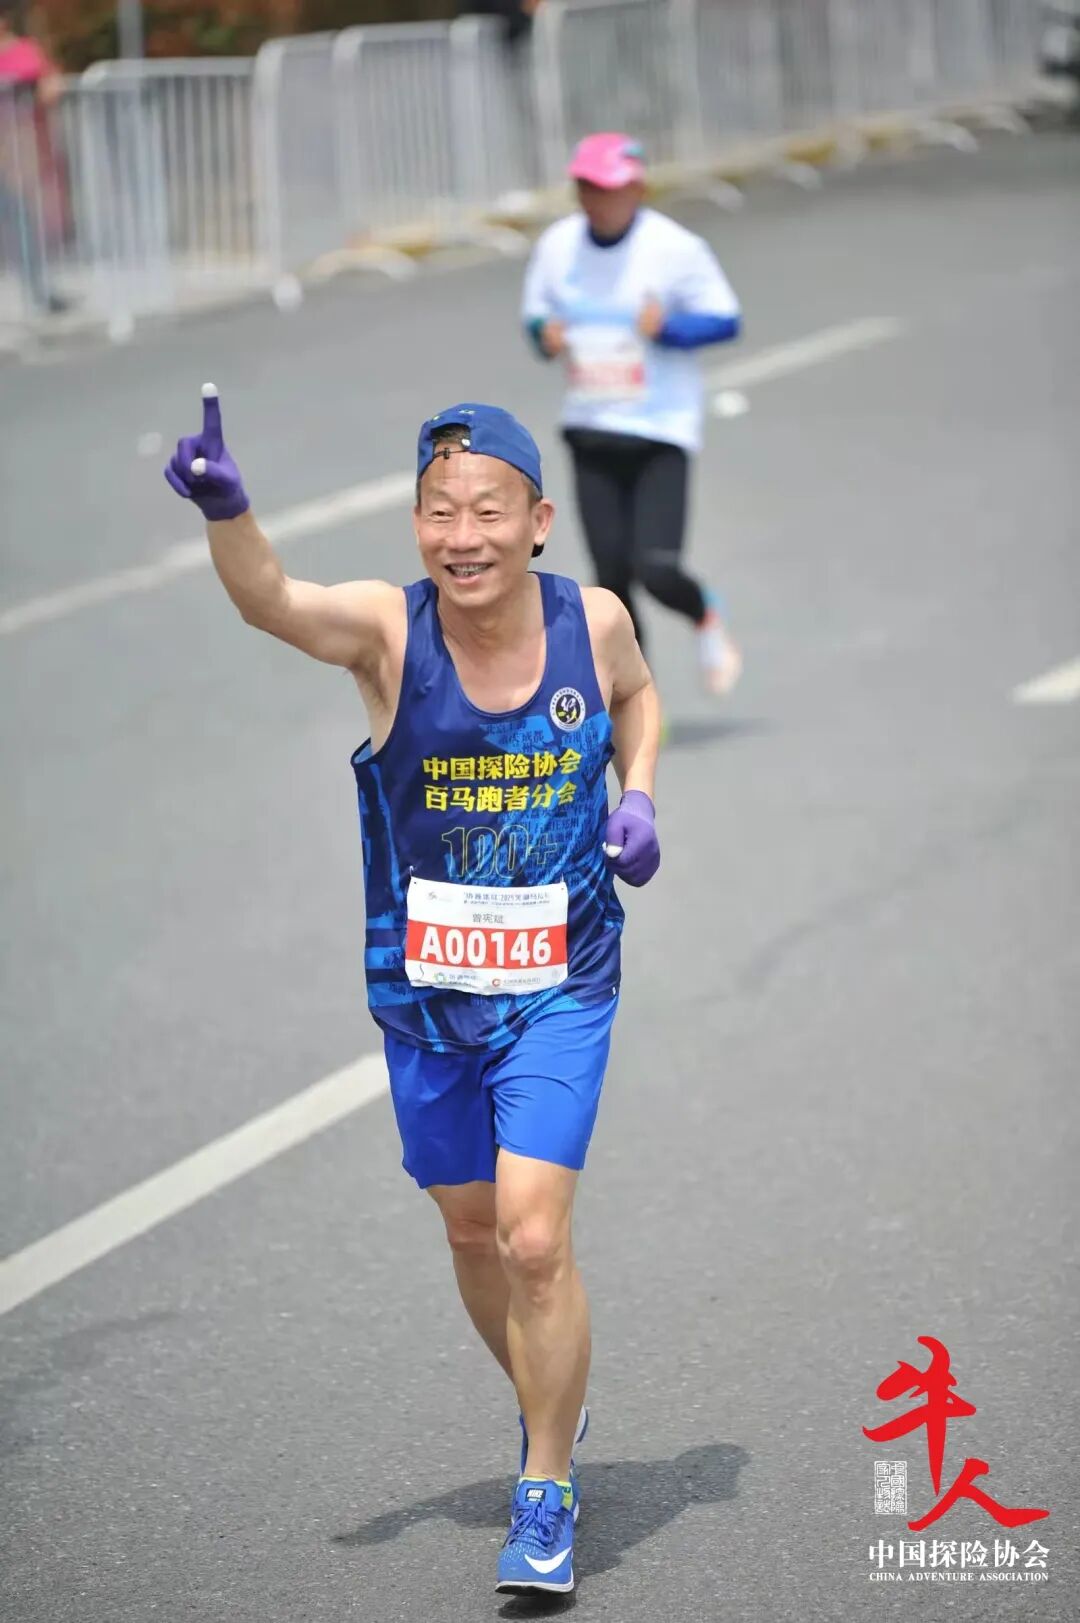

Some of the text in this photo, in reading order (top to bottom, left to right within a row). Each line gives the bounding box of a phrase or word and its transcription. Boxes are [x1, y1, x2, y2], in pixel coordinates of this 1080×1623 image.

[423, 748, 582, 781] 中国探险协会
[424, 781, 577, 812] 百马跑者分会
[441, 824, 558, 880] 100+
[419, 925, 552, 967] A00146
